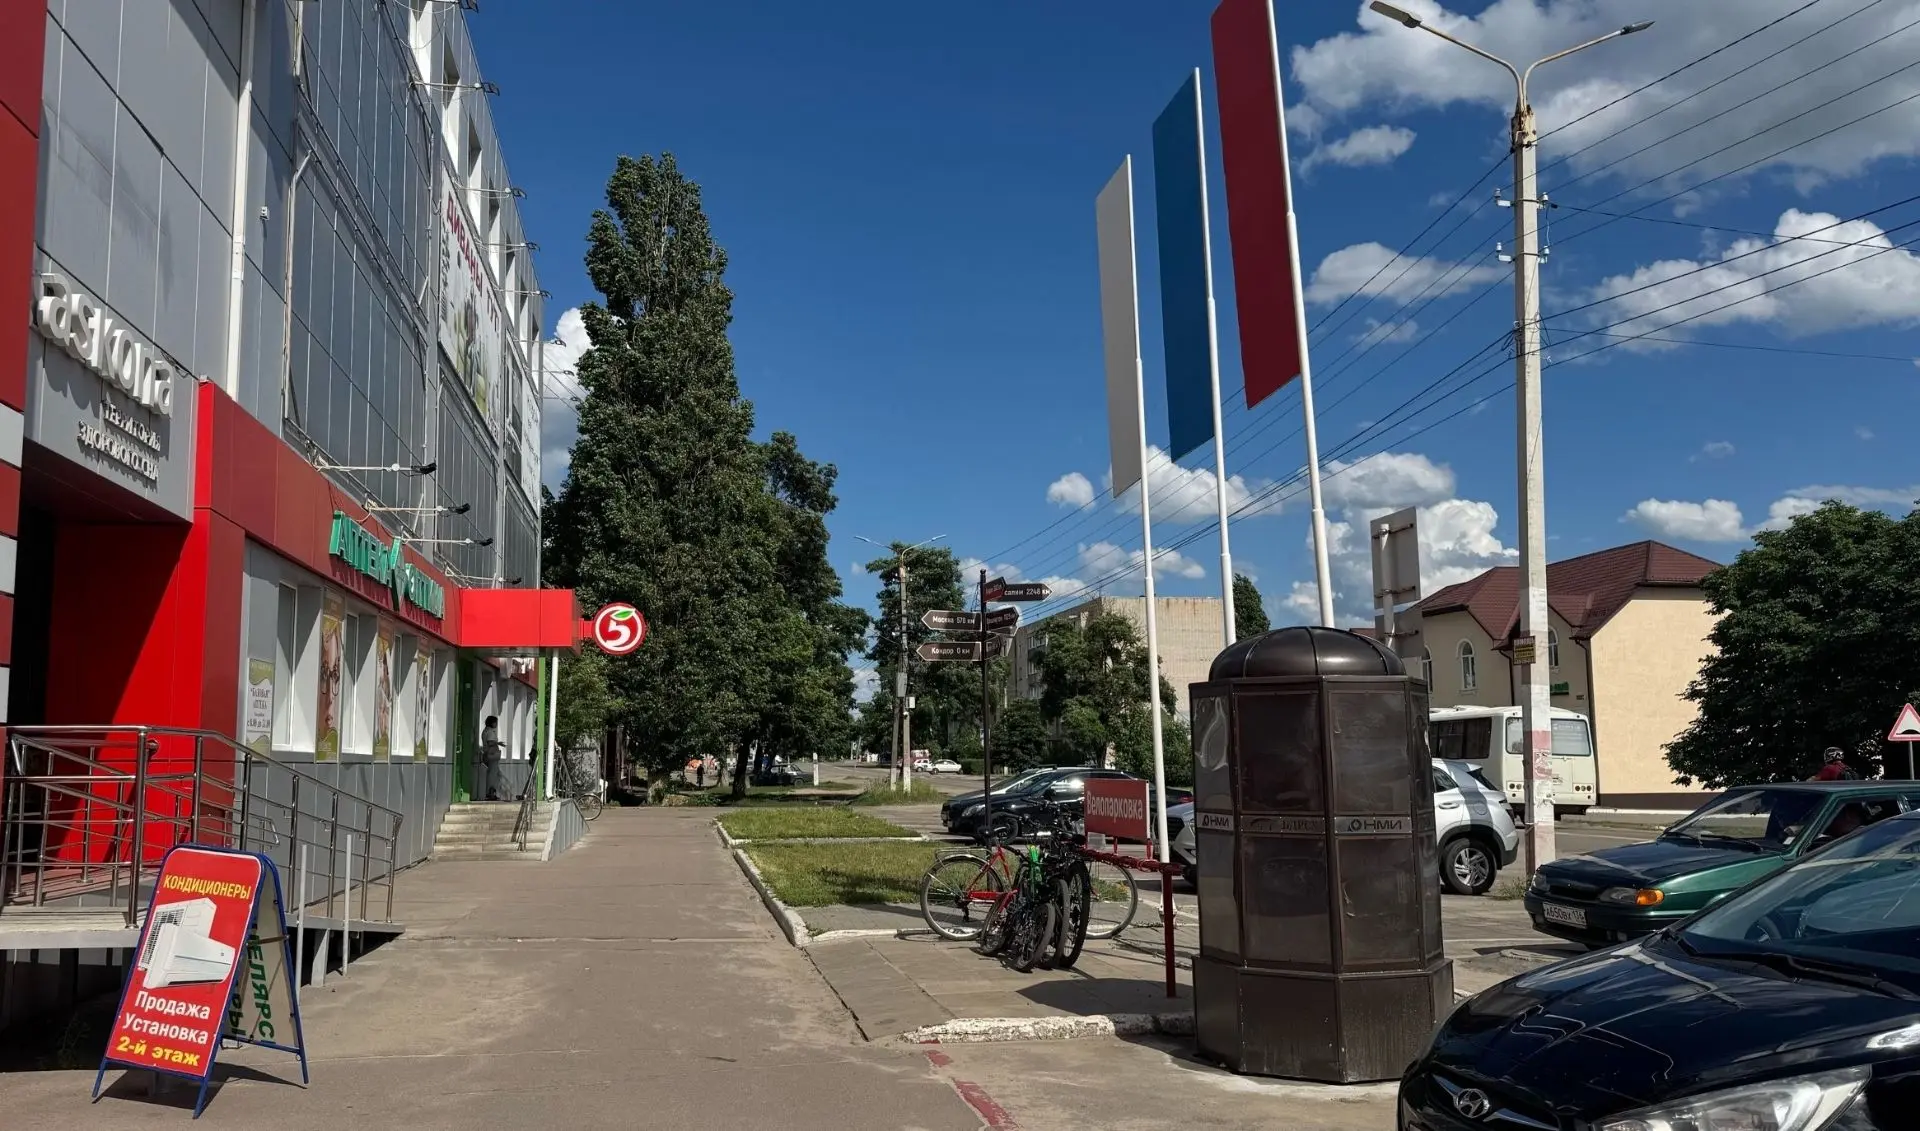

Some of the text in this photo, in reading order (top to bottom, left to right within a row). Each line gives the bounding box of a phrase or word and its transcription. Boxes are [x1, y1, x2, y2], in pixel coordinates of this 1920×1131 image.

[446, 191, 483, 298] ДИВАНЫ
[932, 615, 954, 624] Москва
[1086, 790, 1144, 823] Велопарковка
[163, 873, 251, 900] КОНДИЦИОНЕРЫ
[134, 989, 212, 1020] Продажа
[247, 934, 277, 1044] ЕЛЯРС
[122, 1012, 209, 1046] Установка
[116, 1036, 201, 1067] 2-й этаж
